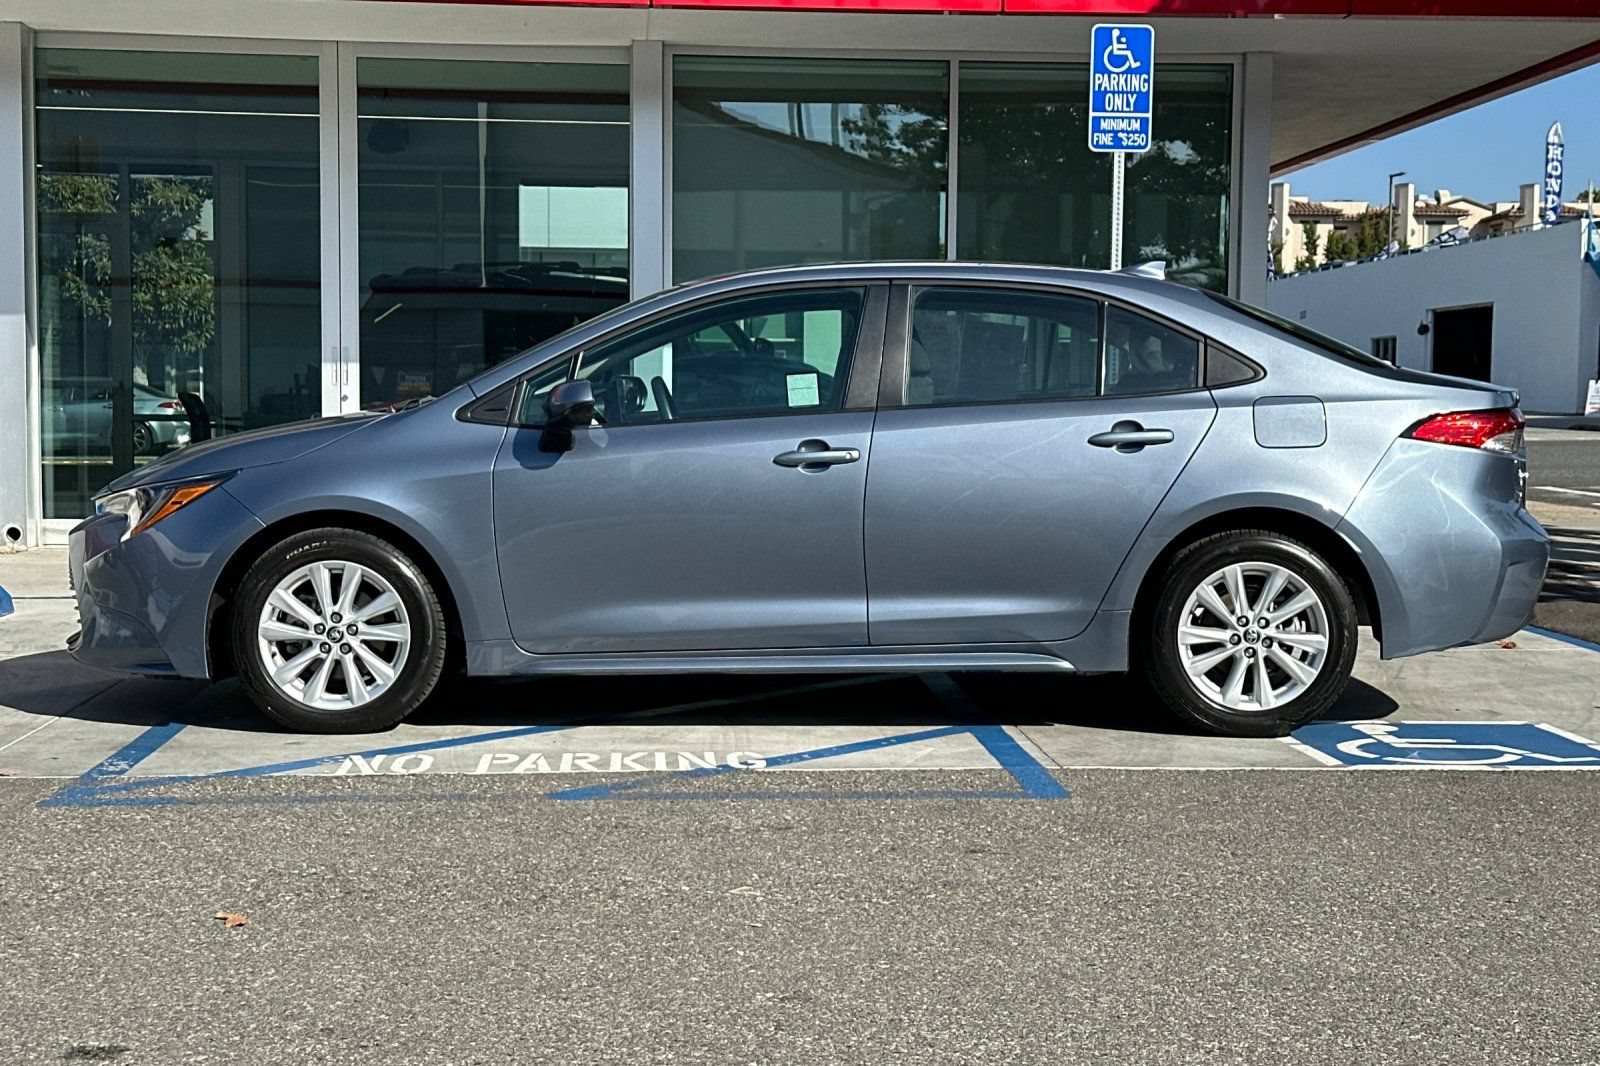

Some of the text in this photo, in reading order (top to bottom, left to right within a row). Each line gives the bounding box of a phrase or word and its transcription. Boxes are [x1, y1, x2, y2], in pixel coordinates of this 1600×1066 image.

[1094, 73, 1149, 92] PARKING
[1105, 93, 1137, 111] ONLY
[1100, 118, 1140, 131] MINIMUM
[1093, 132, 1114, 146] FINE
[334, 751, 767, 774] NO PARKING
